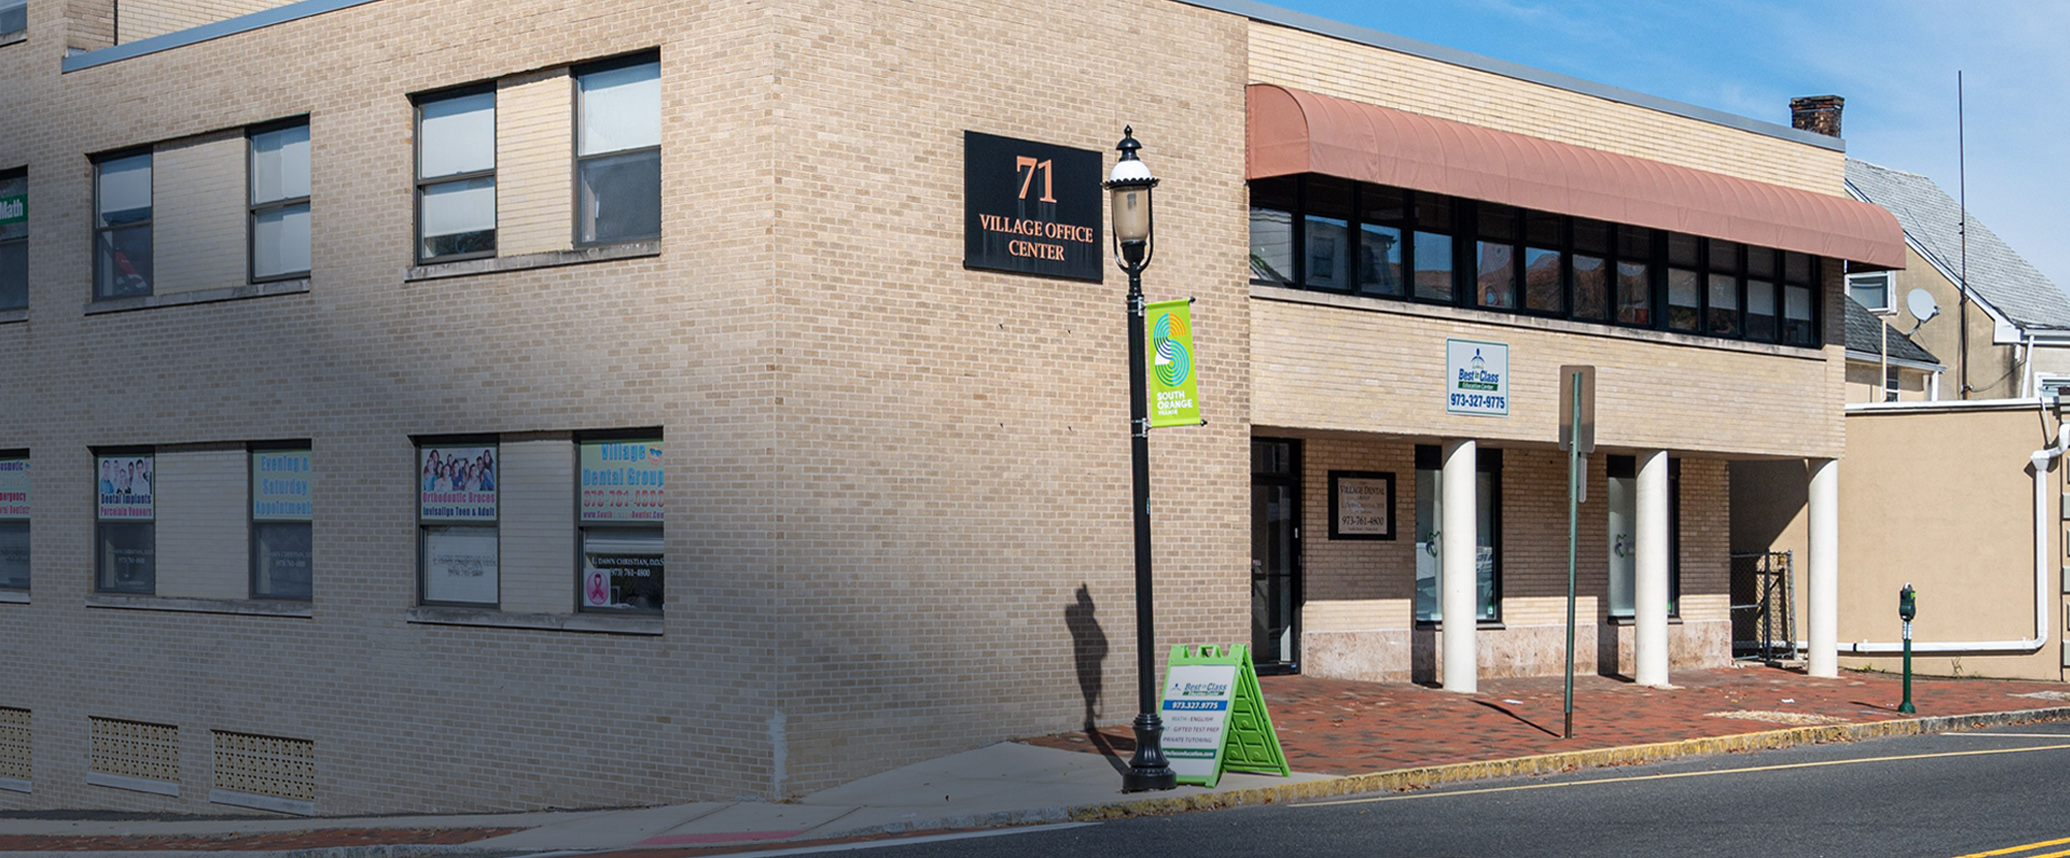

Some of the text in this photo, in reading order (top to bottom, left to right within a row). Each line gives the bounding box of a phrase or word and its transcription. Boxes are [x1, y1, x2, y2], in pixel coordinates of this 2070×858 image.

[1016, 155, 1057, 203] 71
[979, 213, 1093, 243] VILLAGE OFFICE
[1009, 239, 1065, 261] CENTER
[1458, 368, 1474, 381] Best
[1480, 370, 1499, 383] Class
[1157, 391, 1185, 400] SOUTH
[1450, 393, 1505, 409] 973-327-9775
[1157, 399, 1193, 409] ORANGE
[601, 443, 646, 462] Village
[260, 454, 309, 473] Evening &
[583, 467, 664, 487] Dental Group
[262, 478, 307, 496] Saturday
[1340, 485, 1363, 494] VILLAGE
[101, 493, 151, 505] Dental Implants
[422, 492, 495, 503] Orthodontic Braces
[100, 507, 152, 516] Porcelain Veneers
[422, 507, 454, 517] Invisalign
[455, 507, 471, 516] Teen
[477, 507, 495, 516] Adult
[1185, 683, 1202, 691] Best
[1207, 682, 1227, 691] Class
